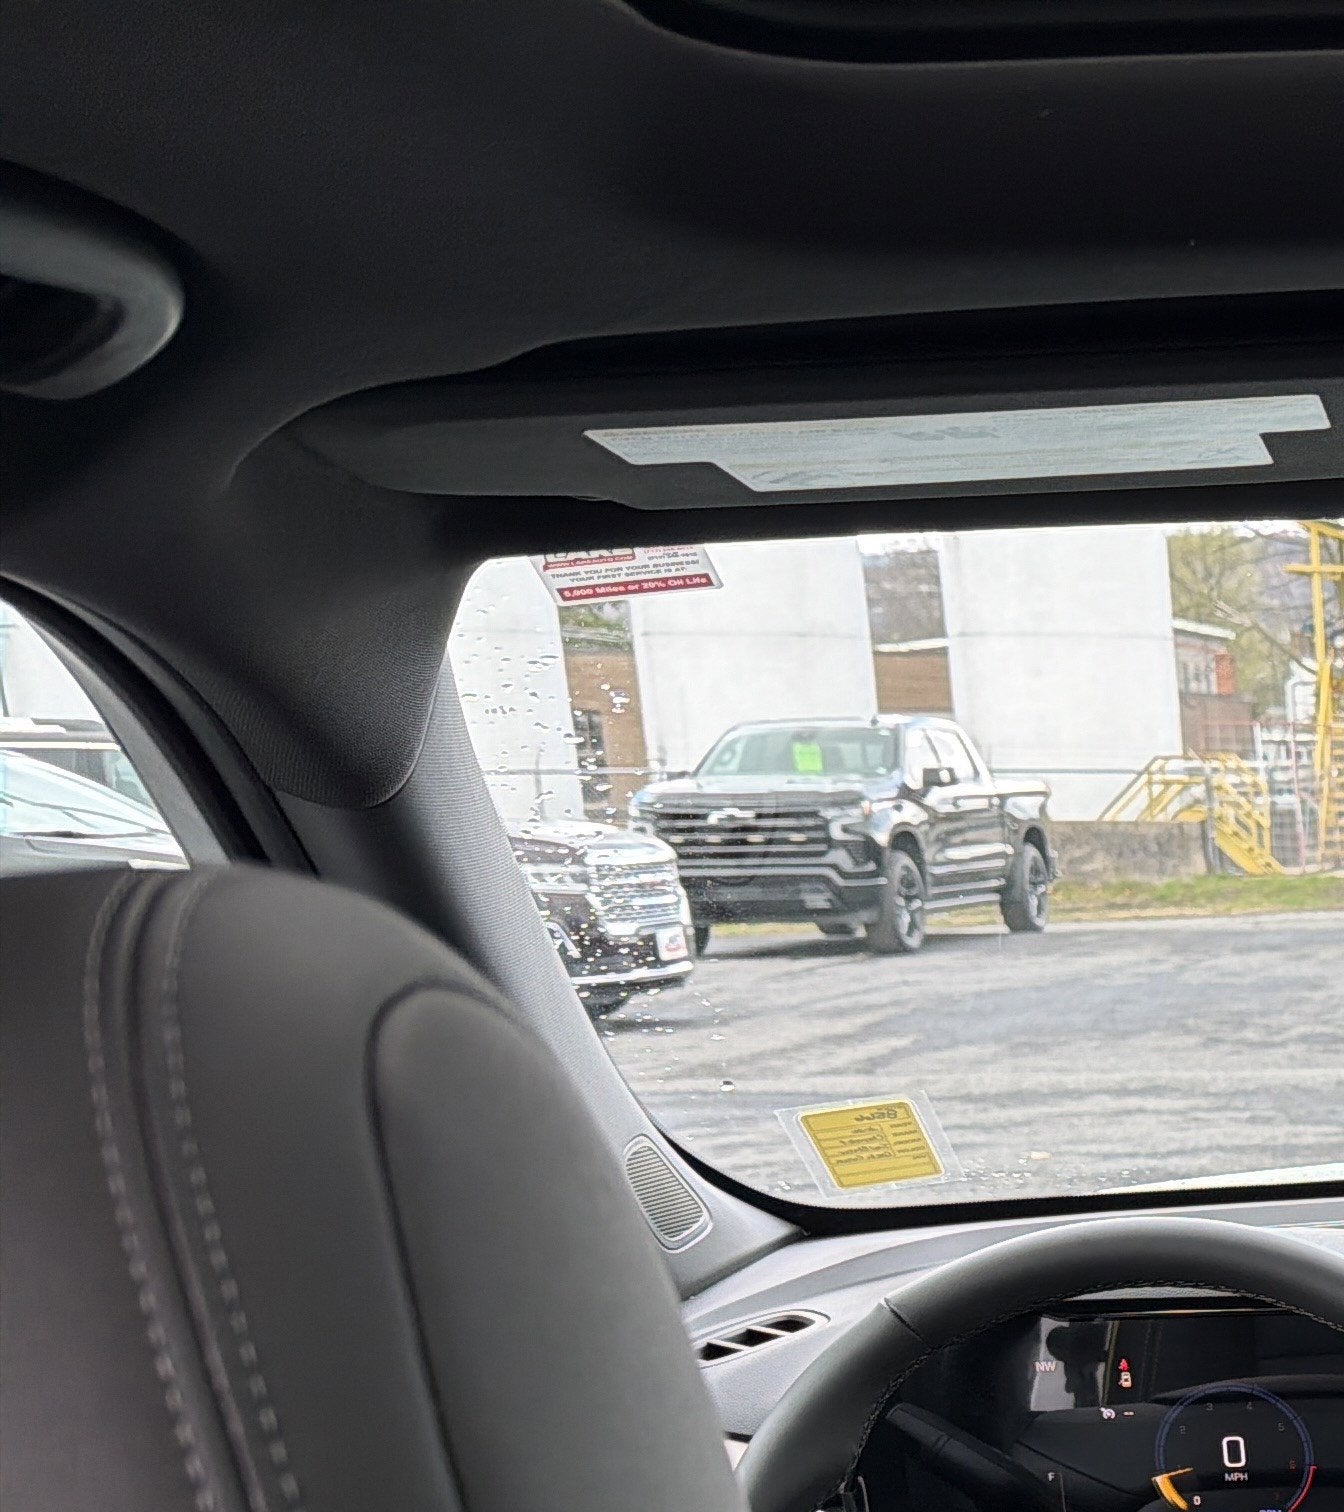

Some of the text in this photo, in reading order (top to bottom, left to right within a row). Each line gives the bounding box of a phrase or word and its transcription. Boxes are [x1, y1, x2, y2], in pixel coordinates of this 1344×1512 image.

[595, 586, 625, 594] Miles
[641, 581, 666, 589] 20%
[685, 576, 707, 585] Life
[1035, 1361, 1056, 1372] NW
[1222, 1436, 1246, 1468] 0
[1048, 1472, 1055, 1481] F
[1225, 1472, 1248, 1481] MPH
[1193, 1496, 1201, 1505] 0
